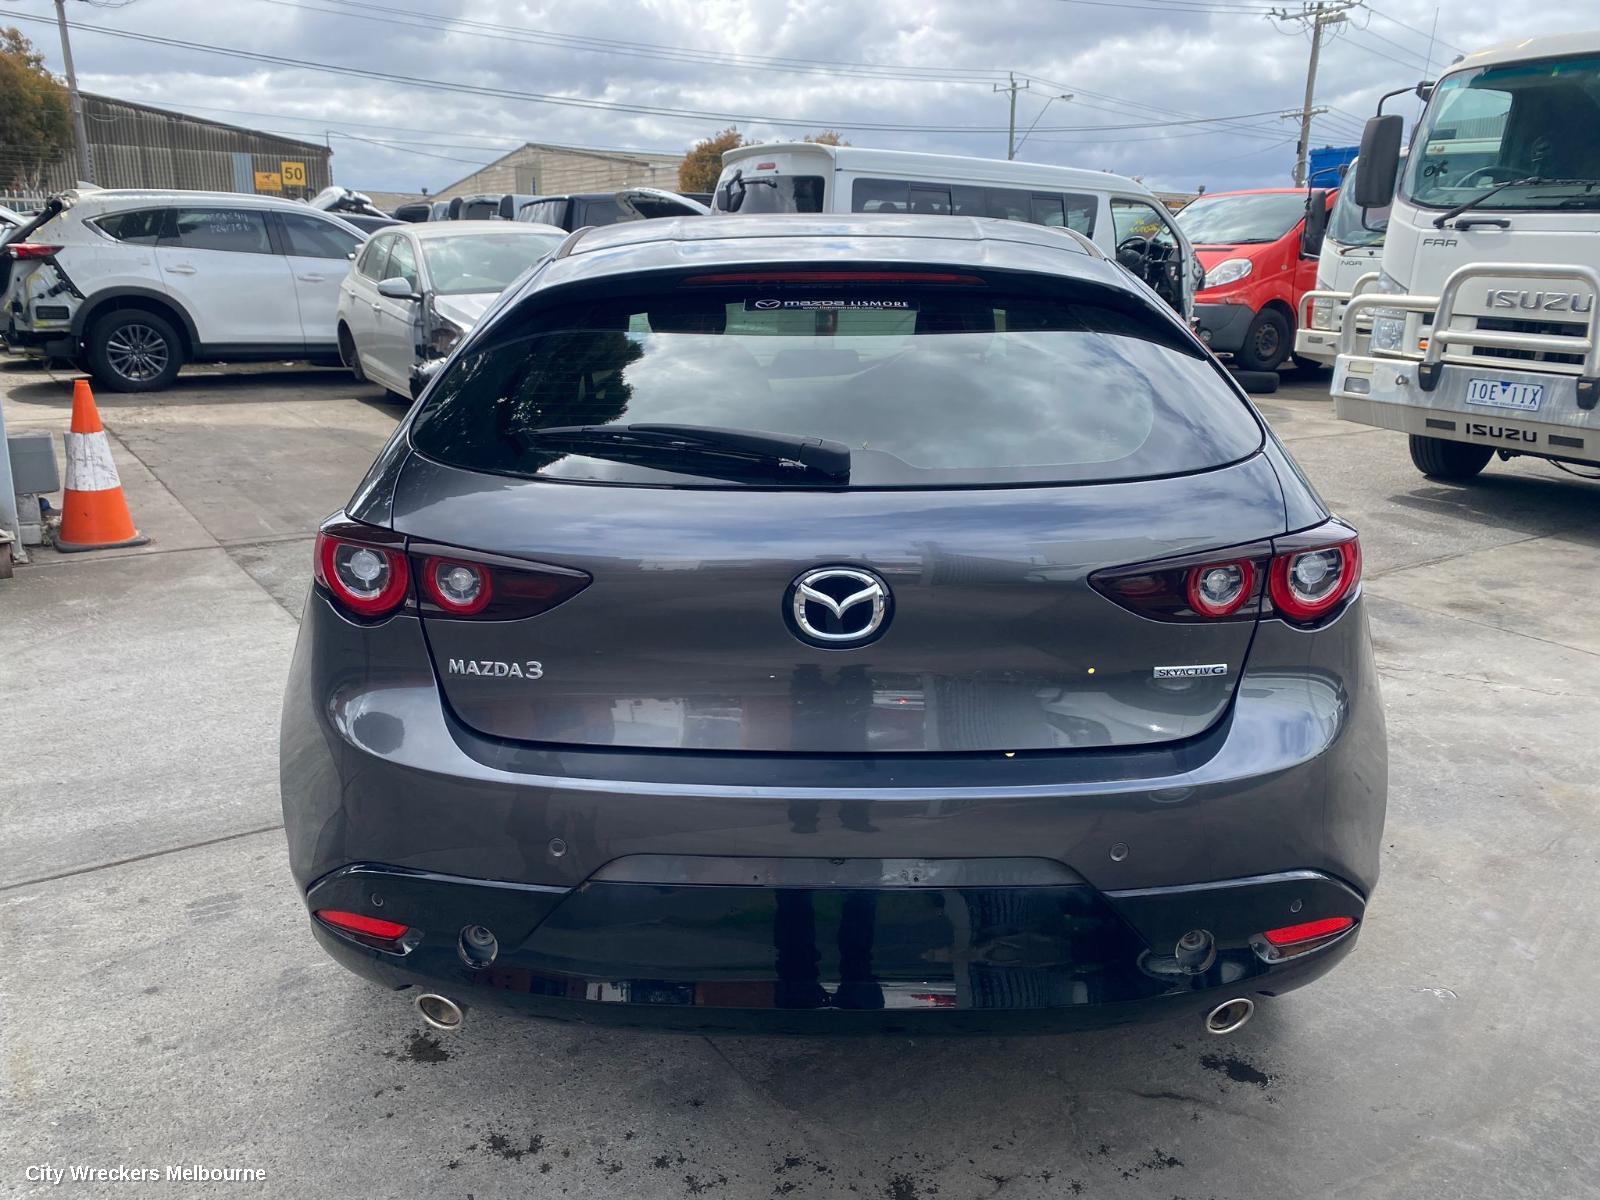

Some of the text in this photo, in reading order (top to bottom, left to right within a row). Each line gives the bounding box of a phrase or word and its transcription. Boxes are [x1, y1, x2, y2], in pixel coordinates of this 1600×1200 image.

[285, 167, 303, 180] 50
[850, 300, 909, 308] LISMORE
[1486, 289, 1594, 313] ISUZU
[1465, 422, 1537, 443] ISUZU
